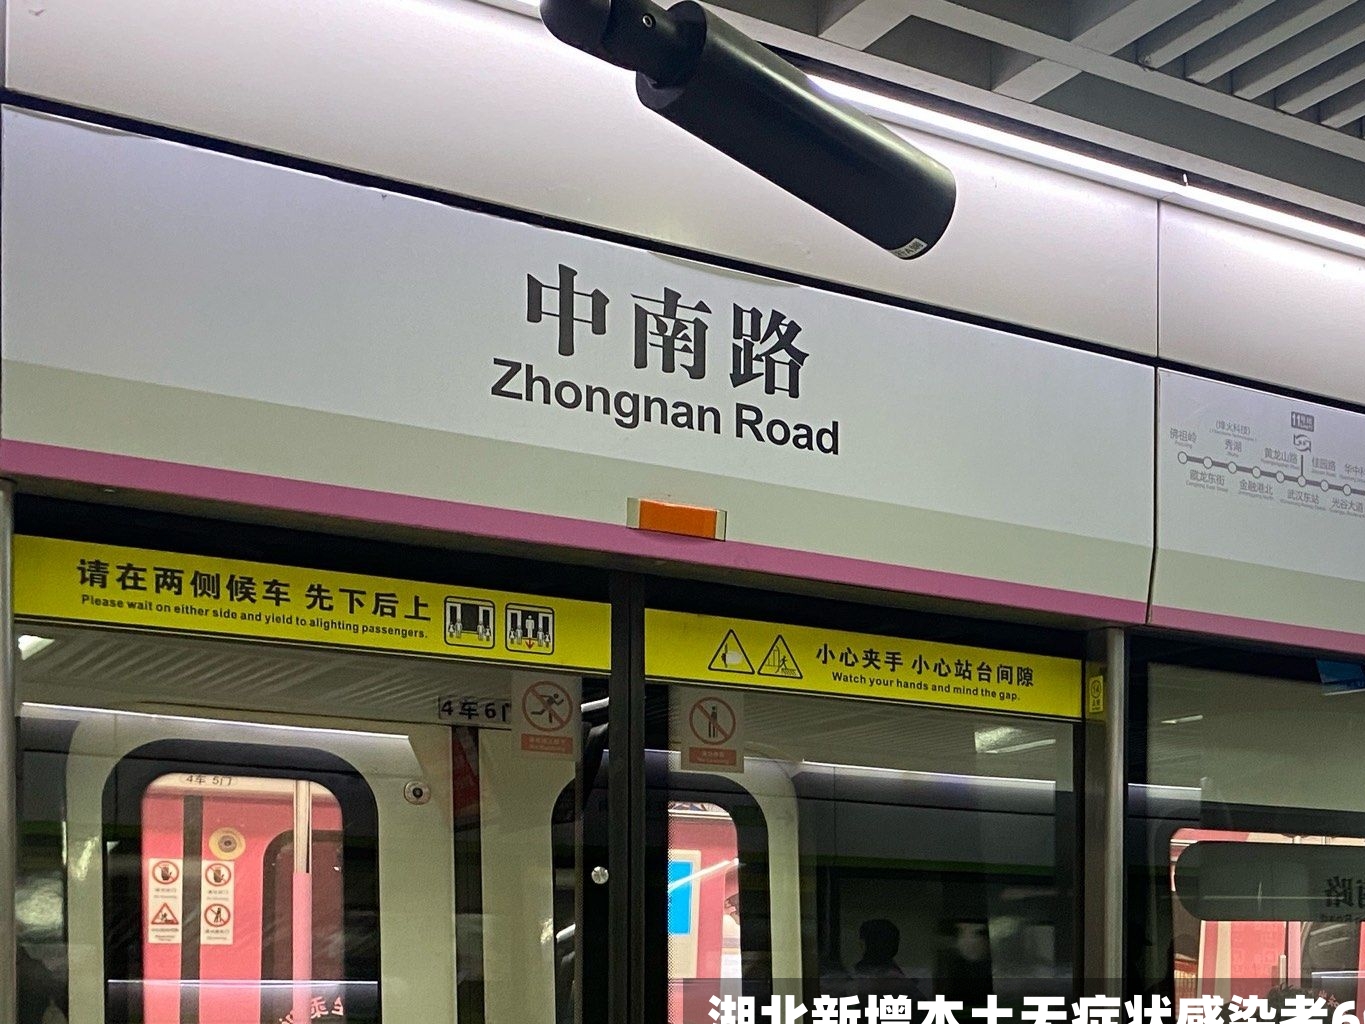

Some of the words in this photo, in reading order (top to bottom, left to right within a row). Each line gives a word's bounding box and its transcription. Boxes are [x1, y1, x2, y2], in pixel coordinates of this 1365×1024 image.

[527, 264, 809, 399] 中南路
[491, 358, 721, 436] Zhongnan
[735, 402, 839, 455] Road
[77, 559, 291, 606] 请在两侧候车
[305, 584, 431, 621] 先下后上
[82, 594, 124, 609] Please
[127, 600, 153, 611] wait
[156, 604, 171, 613] on
[174, 604, 209, 616] either
[212, 608, 237, 619] side
[240, 611, 262, 622] and
[265, 613, 293, 626] yield
[295, 616, 307, 626] to
[309, 618, 359, 634] alighting
[362, 625, 428, 639] passengers.
[816, 643, 904, 674] 小心夹手
[911, 653, 1034, 690] 小心站台间隙
[832, 671, 866, 684] Watch
[869, 676, 894, 688] your
[896, 677, 929, 691] hands
[931, 683, 950, 693] and
[953, 685, 979, 697] mind
[980, 688, 997, 698] the
[999, 690, 1021, 702] gap.
